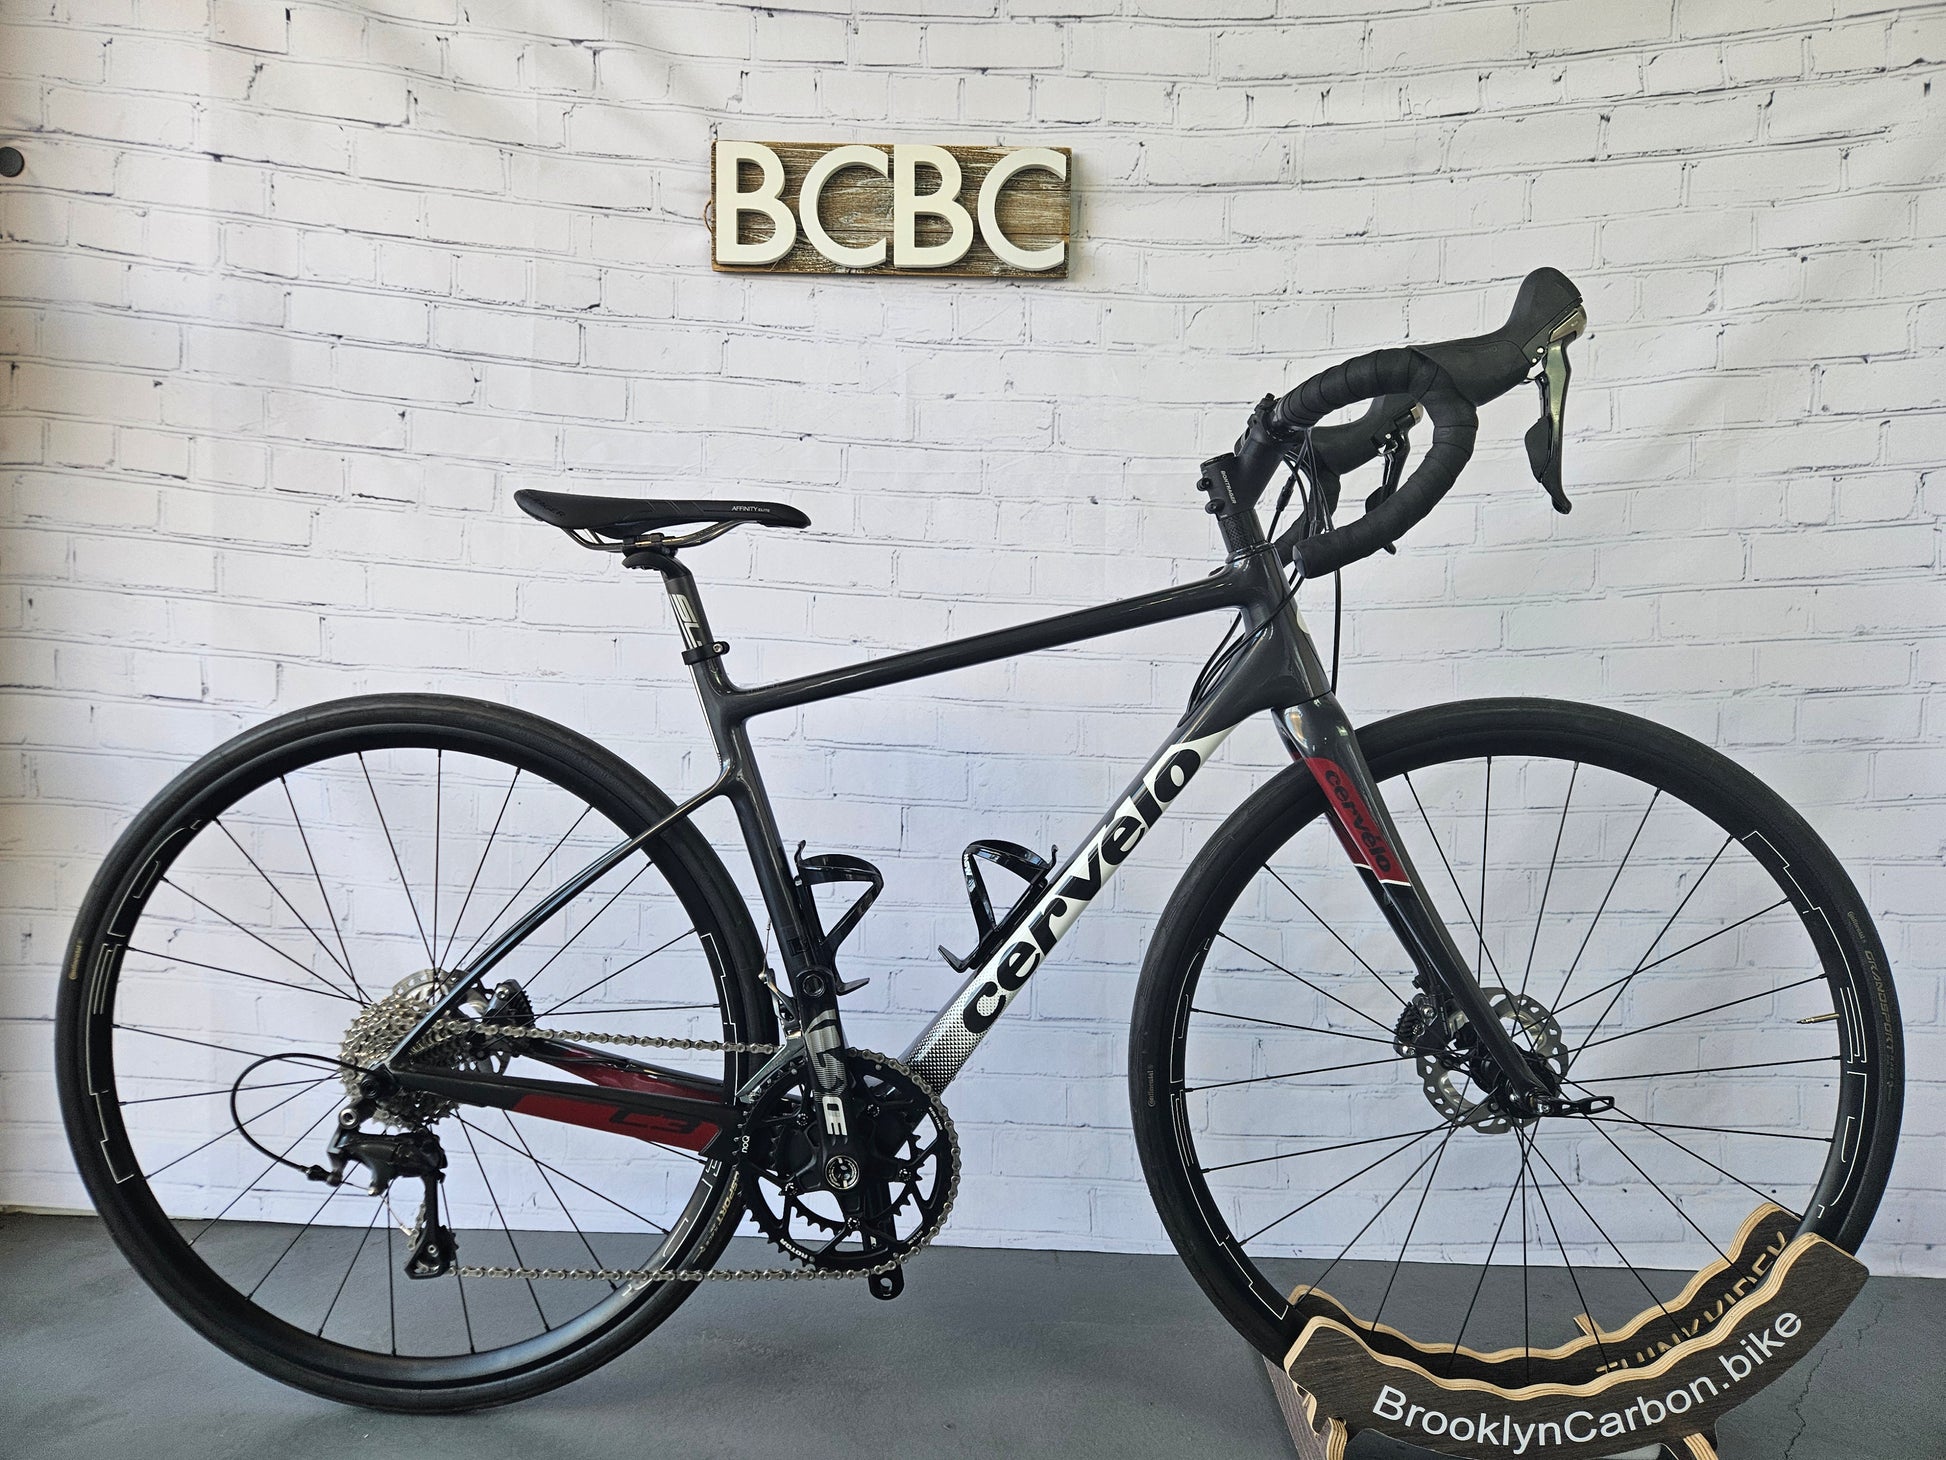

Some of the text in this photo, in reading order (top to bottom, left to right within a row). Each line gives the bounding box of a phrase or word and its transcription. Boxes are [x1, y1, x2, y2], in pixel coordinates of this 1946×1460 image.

[716, 140, 1067, 271] BCBC
[779, 1238, 810, 1262] ROTOR
[1372, 1311, 1803, 1455] BrooklynCarbon.bike
